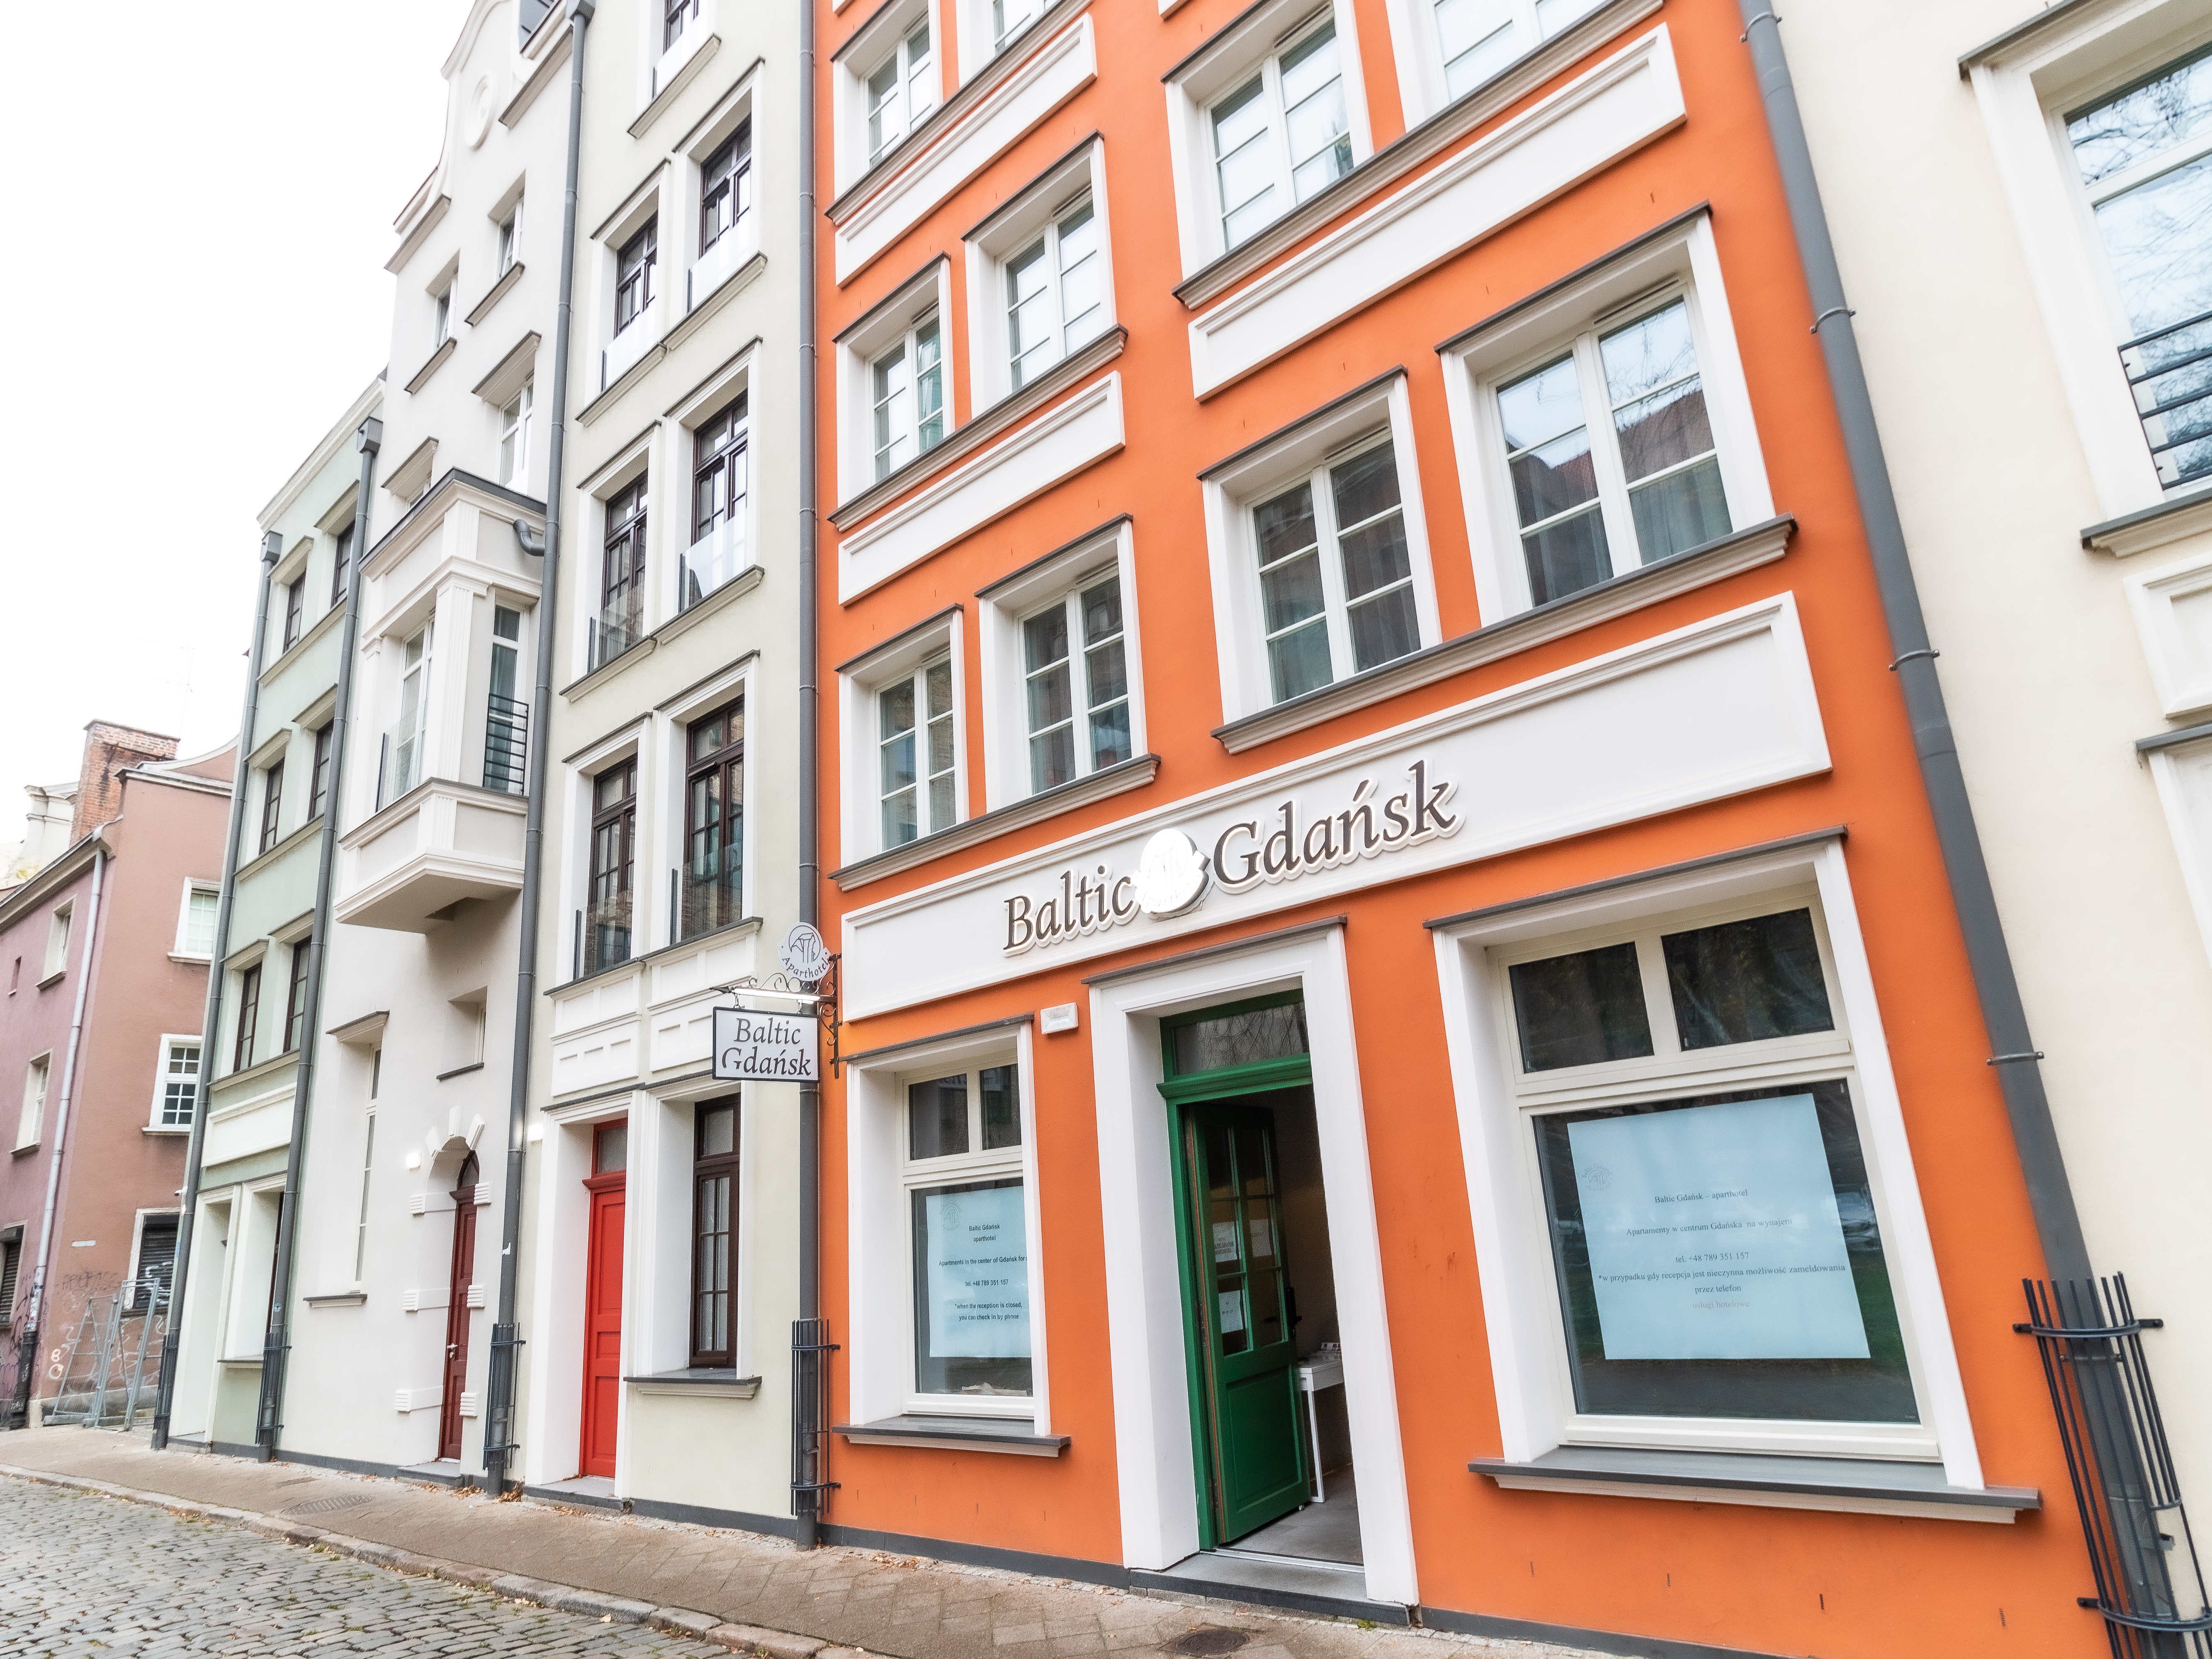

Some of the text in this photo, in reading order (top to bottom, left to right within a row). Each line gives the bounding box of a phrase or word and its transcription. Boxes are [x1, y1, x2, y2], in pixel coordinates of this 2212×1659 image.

[1003, 760, 1457, 951] Baltic Gdańsk
[782, 957, 828, 978] Aparthotel
[734, 1017, 800, 1044] Baltic
[722, 1046, 812, 1076] Gdańsk
[1677, 1193, 1703, 1201] Gdańsk
[1712, 1189, 1748, 1199] aparthotel
[1626, 1227, 1670, 1236] Apartamenty
[1711, 1221, 1742, 1230] Gdańska
[1758, 1218, 1792, 1228] wynajem
[1610, 1273, 1645, 1282] przypadku
[1647, 1272, 1659, 1280] gdy
[1662, 1271, 1690, 1280] recepcja
[1692, 1270, 1705, 1279] jest
[1707, 1269, 1744, 1277] nieczynna
[1746, 1266, 1786, 1275] możliwość
[1789, 1264, 1845, 1273] zameldowania
